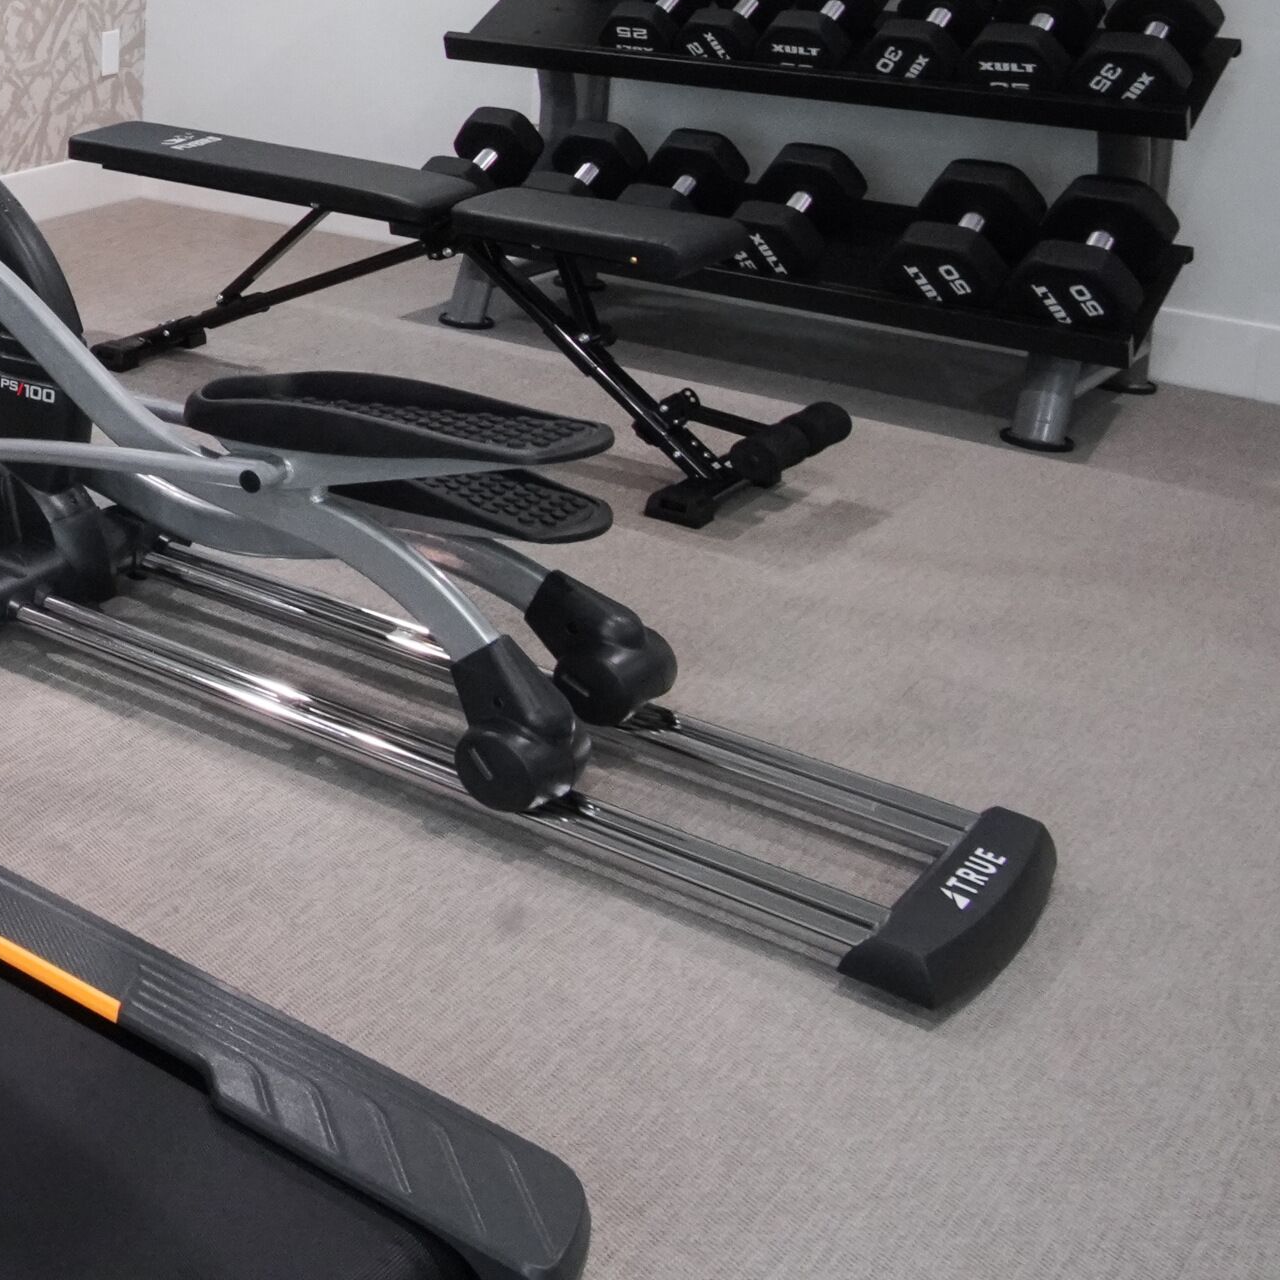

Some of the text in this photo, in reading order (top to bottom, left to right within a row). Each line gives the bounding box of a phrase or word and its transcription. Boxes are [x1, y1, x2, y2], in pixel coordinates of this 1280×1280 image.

[616, 27, 648, 39] 25
[686, 40, 709, 58] 2
[772, 44, 820, 56] XULT
[876, 46, 902, 73] 30
[905, 54, 929, 78] XUL
[979, 62, 1036, 72] XULT
[1089, 63, 1122, 92] 35
[1119, 70, 1154, 99] XUL
[747, 233, 787, 276] XULT
[938, 265, 971, 297] 50
[1068, 285, 1104, 318] 50
[0, 377, 56, 404] PS/100
[946, 847, 1007, 894] TRUE
